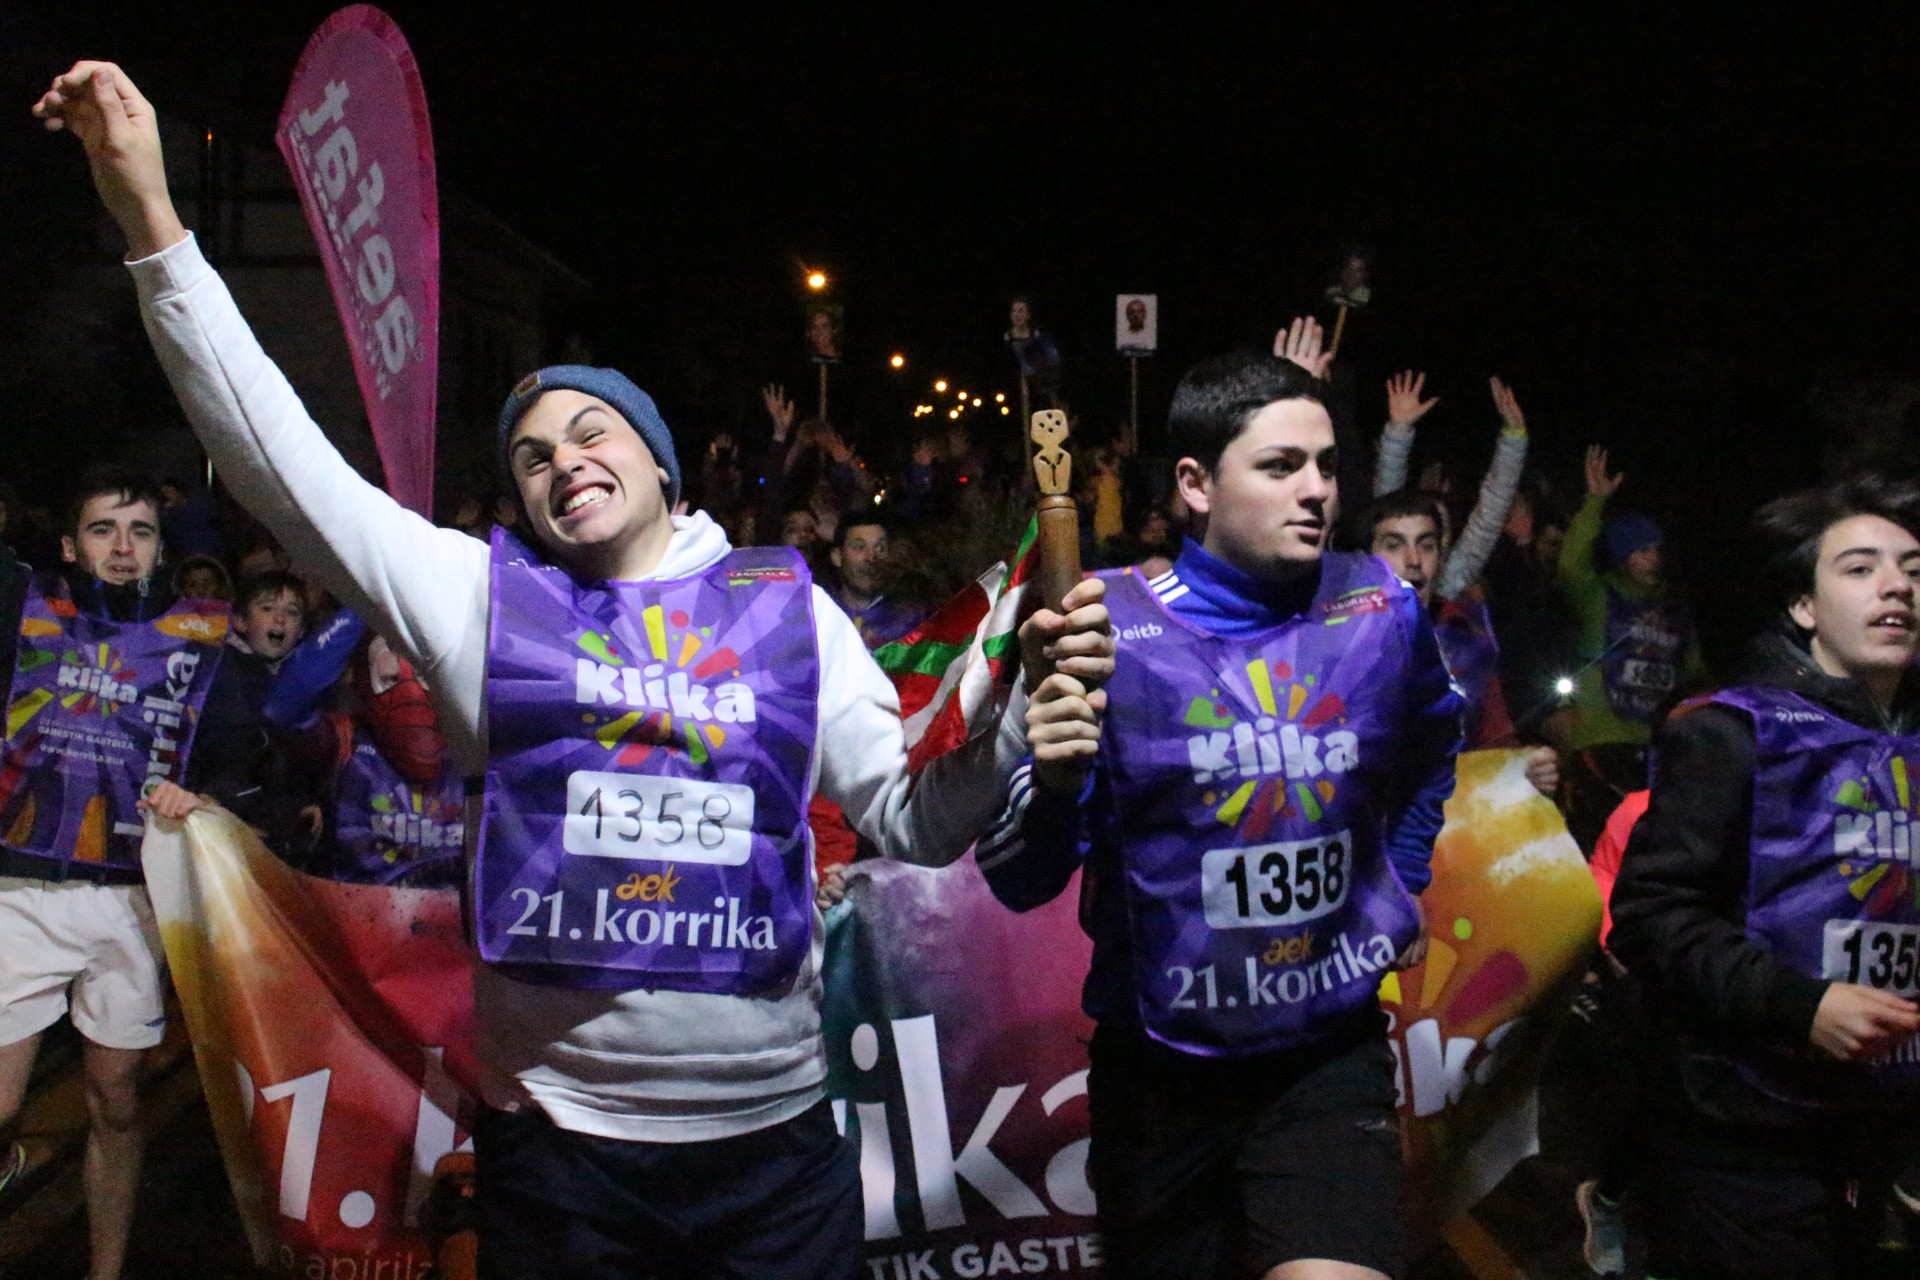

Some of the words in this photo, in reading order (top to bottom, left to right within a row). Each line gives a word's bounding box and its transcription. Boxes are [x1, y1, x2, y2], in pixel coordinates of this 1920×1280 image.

[1126, 623, 1163, 642] eitb
[580, 786, 733, 850] 1358
[1834, 810, 1920, 870] Kli
[615, 864, 682, 903] aek
[1225, 841, 1345, 918] 1358
[506, 888, 581, 940] 21.
[593, 889, 778, 950] korrika
[1166, 965, 1236, 1009] 21.
[1246, 932, 1396, 1006] korrika
[236, 1059, 376, 1229] 1.
